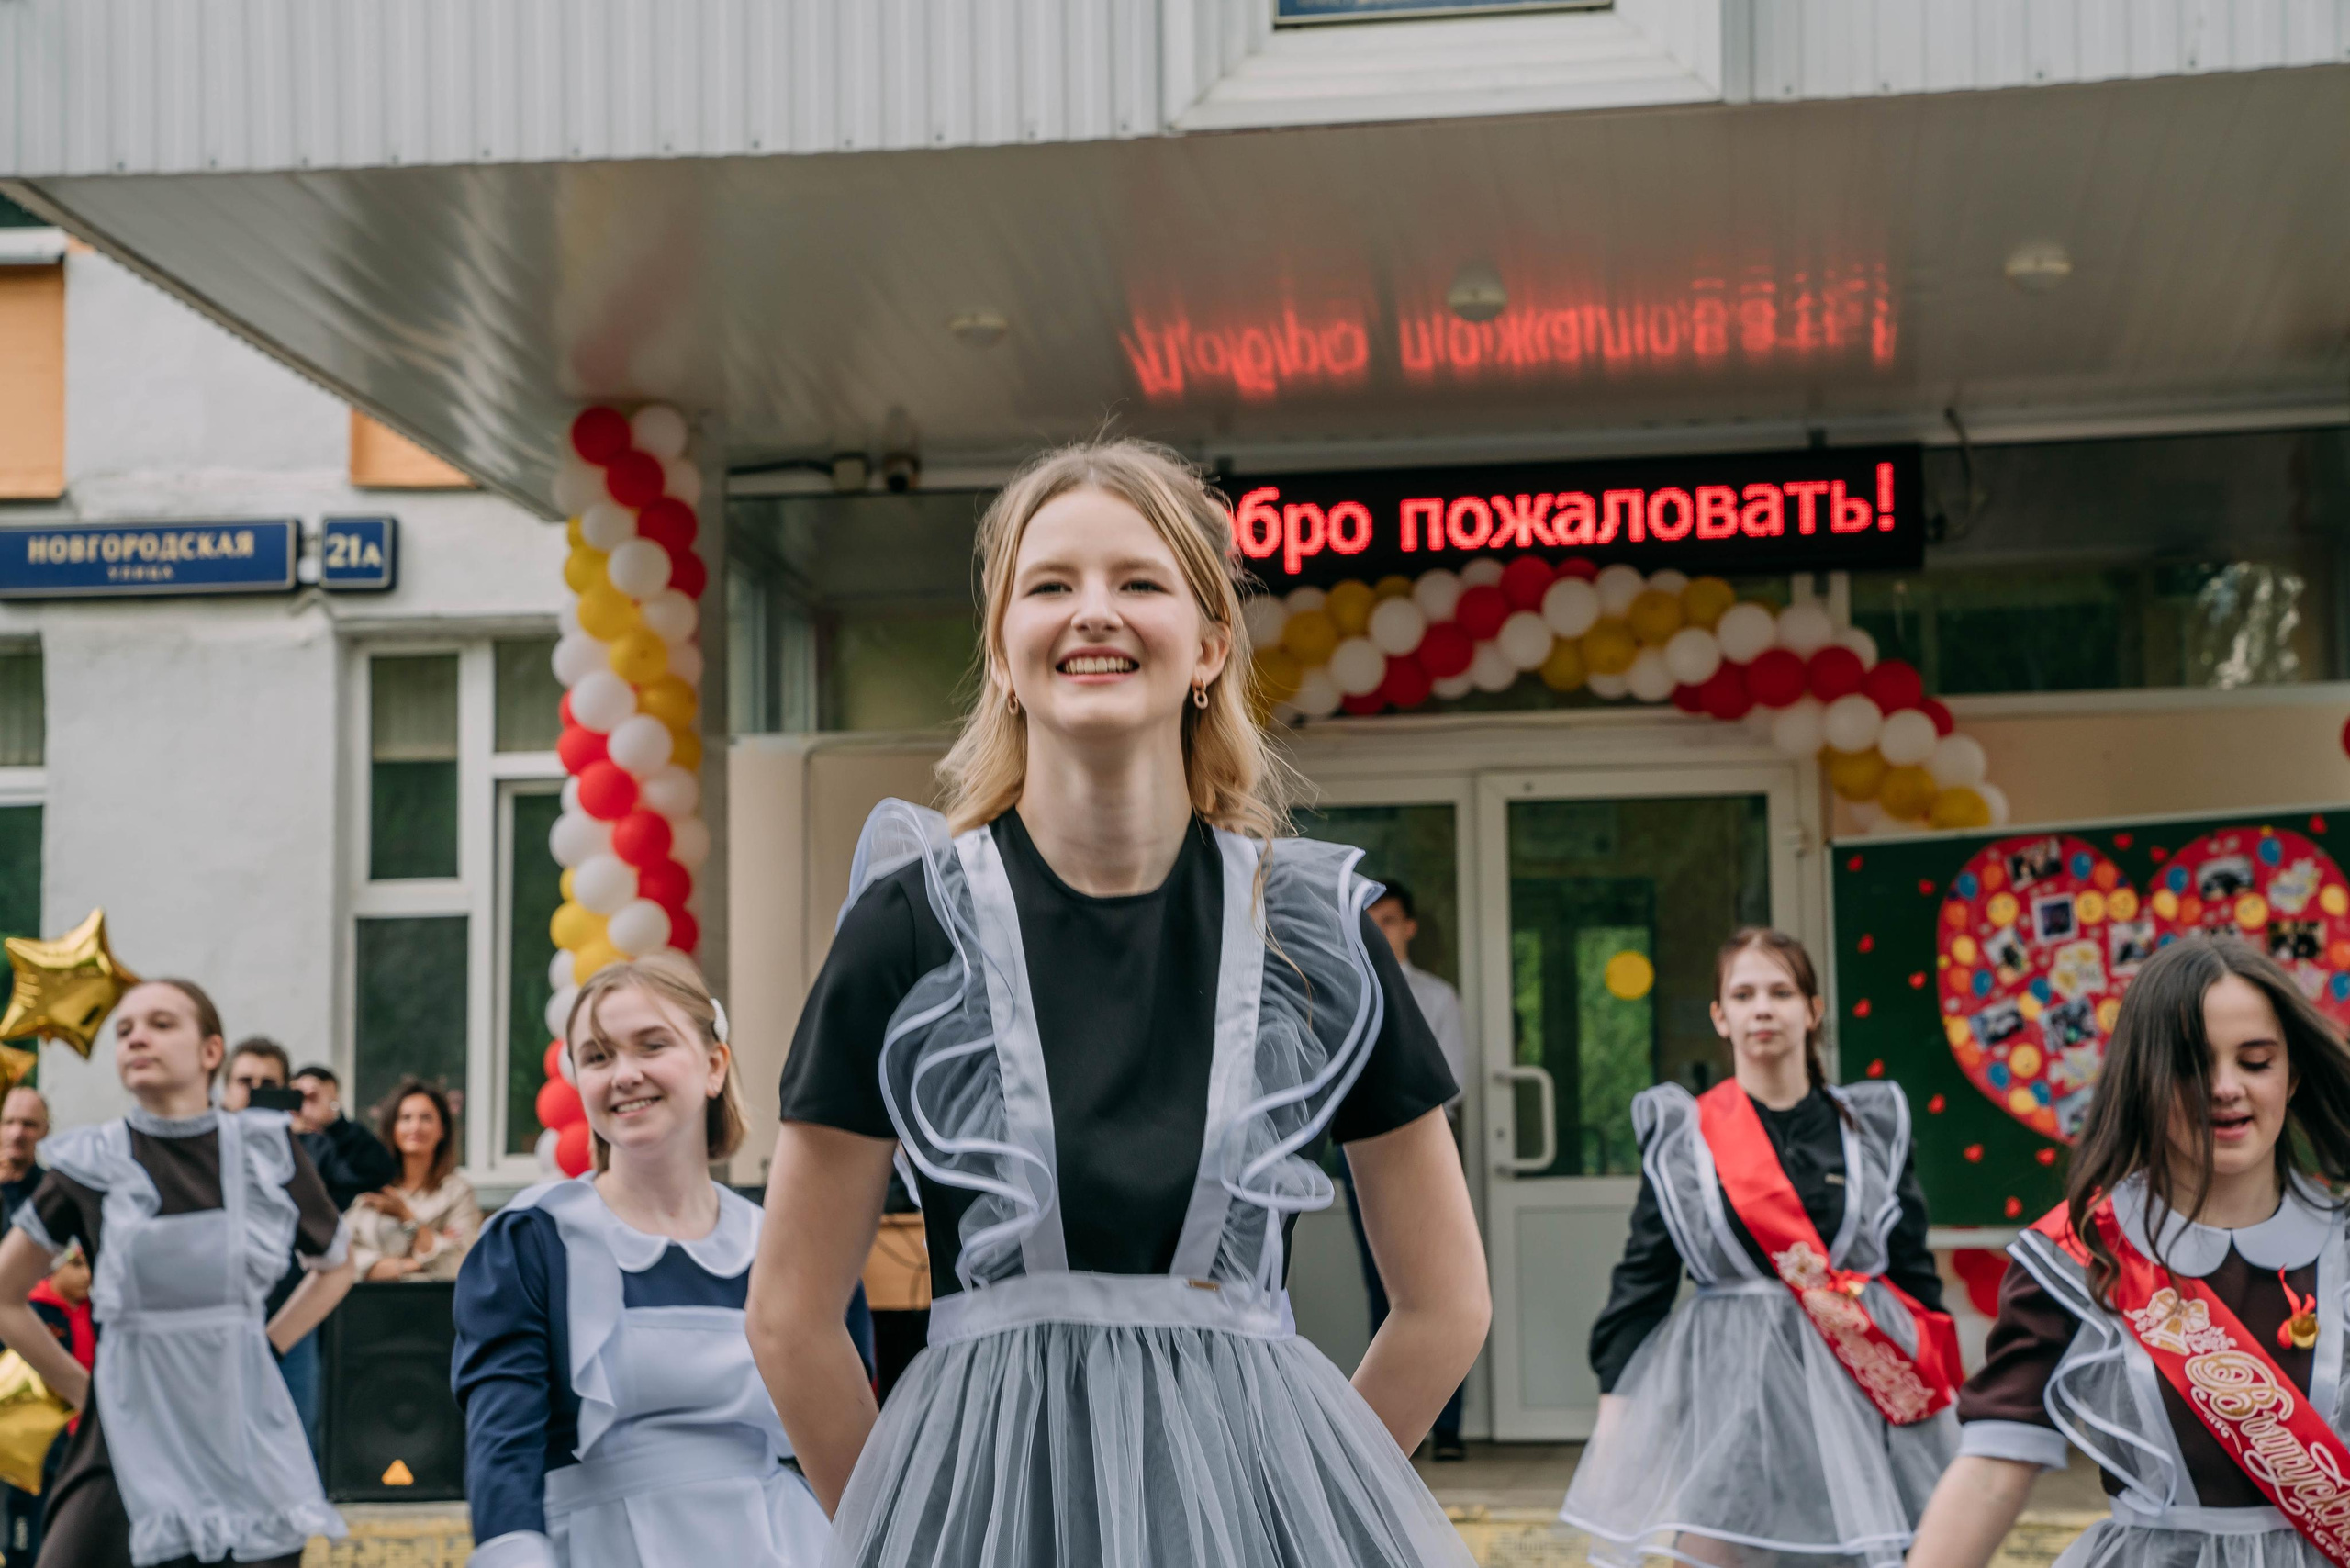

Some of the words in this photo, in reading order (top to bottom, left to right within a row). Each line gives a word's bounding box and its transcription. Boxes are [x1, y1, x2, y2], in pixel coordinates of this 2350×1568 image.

[1225, 486, 1373, 575] бро
[1399, 462, 1895, 552] пожаловать!
[27, 530, 255, 564] НОВГОРОДСКАЯ
[326, 533, 382, 568] 21А
